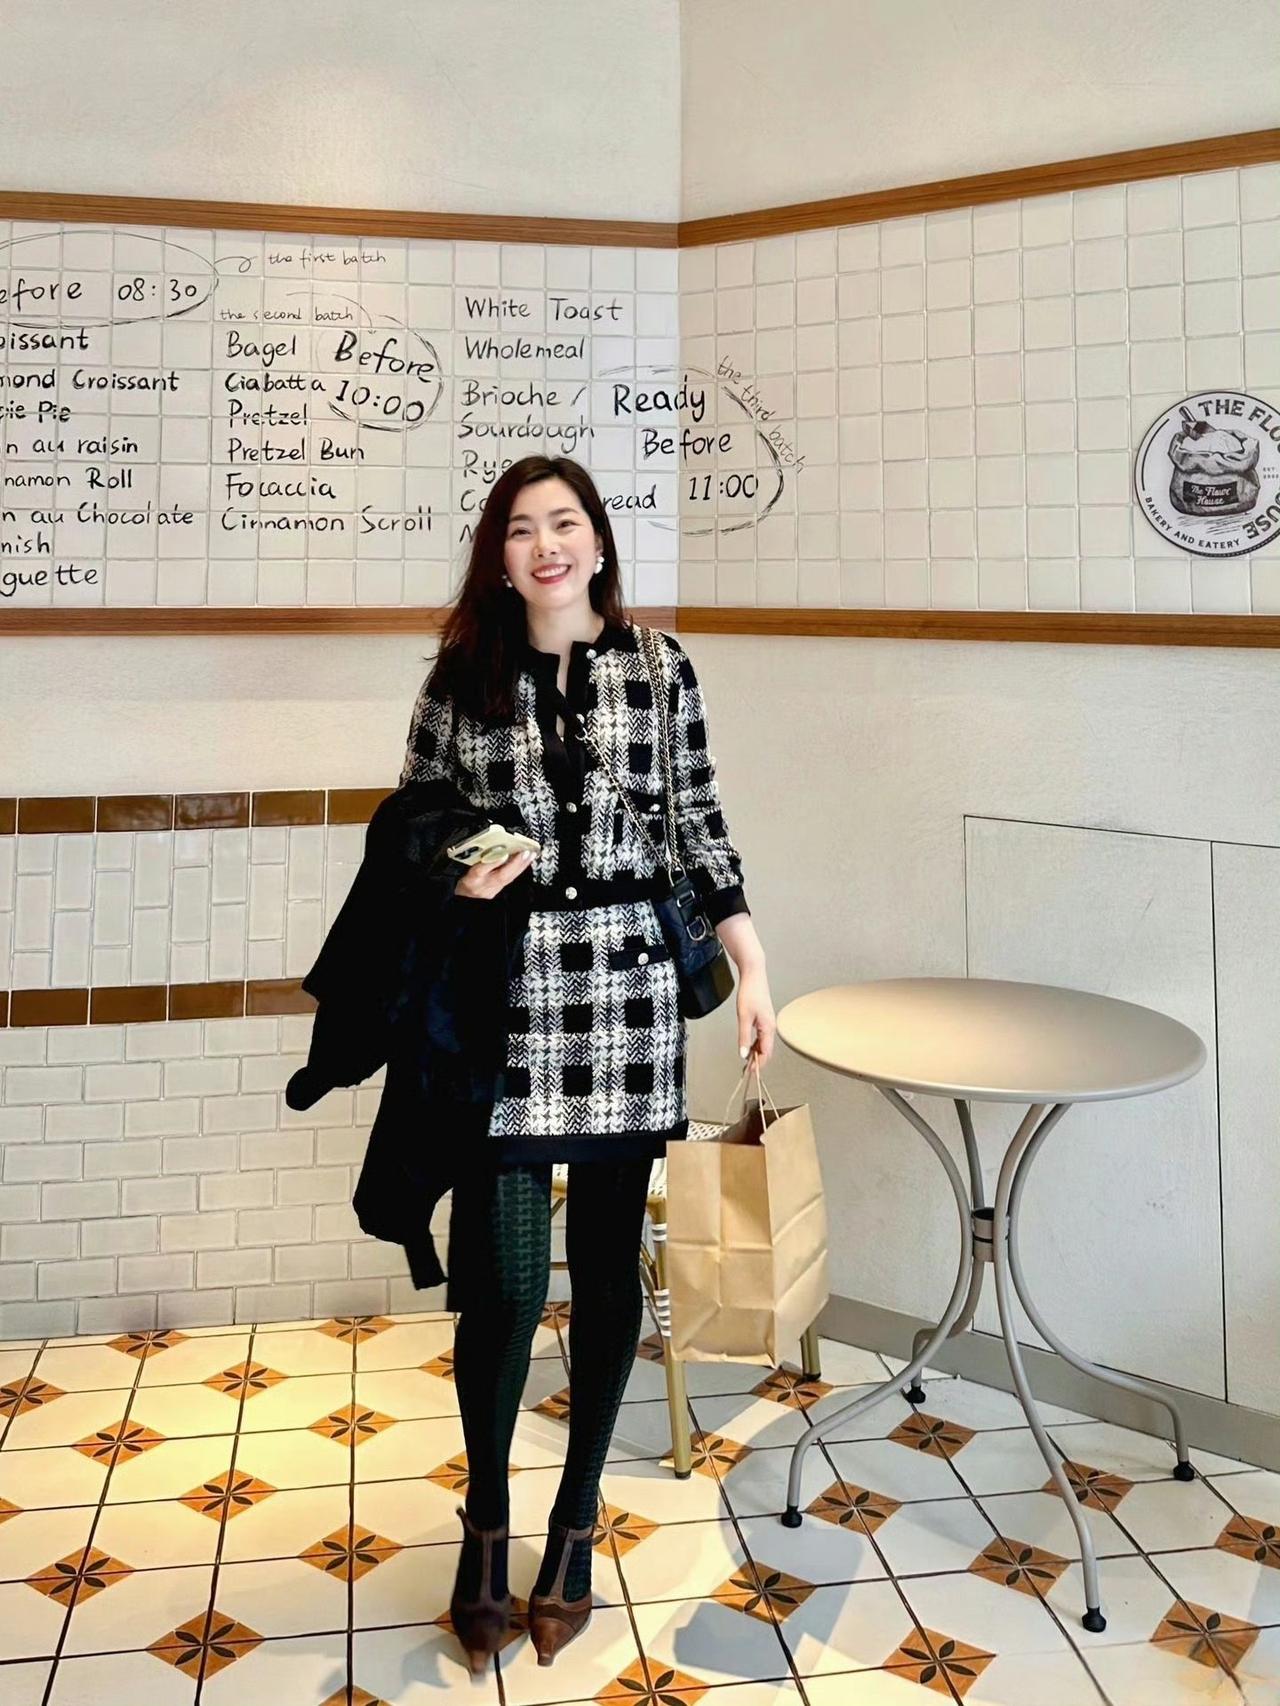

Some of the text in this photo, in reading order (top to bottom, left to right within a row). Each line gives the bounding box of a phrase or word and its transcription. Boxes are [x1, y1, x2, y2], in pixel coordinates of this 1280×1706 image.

[299, 248, 336, 269] first
[343, 249, 386, 266] batch
[118, 277, 197, 302] 08:30
[314, 307, 353, 321] batch
[465, 296, 623, 321] White Toast
[226, 331, 297, 368] Bagel
[334, 331, 434, 383] Before
[465, 336, 585, 360] Wholemeal
[72, 369, 180, 391] Croissant
[225, 373, 327, 392] Ciabatta
[716, 355, 742, 384] the
[335, 380, 424, 422] 10:00
[461, 379, 561, 407] Brioche
[612, 374, 705, 422] Ready
[39, 400, 71, 423] Pie
[228, 399, 308, 429] Pretzel
[457, 412, 597, 453] Sourdough
[1198, 399, 1280, 454] THE FLO
[32, 439, 64, 453] au
[77, 436, 138, 455] raisin
[228, 437, 364, 462] Pretzel Bun
[642, 428, 733, 467] Before
[86, 467, 132, 489] Roll
[226, 472, 336, 500] Focaccia
[689, 474, 759, 501] 11:00
[31, 510, 64, 524] au
[77, 501, 193, 525] Chocolate
[221, 506, 344, 531] Cinnamon
[360, 505, 432, 534] Scroll
[1145, 497, 1240, 549] BAKERY AND EATERY
